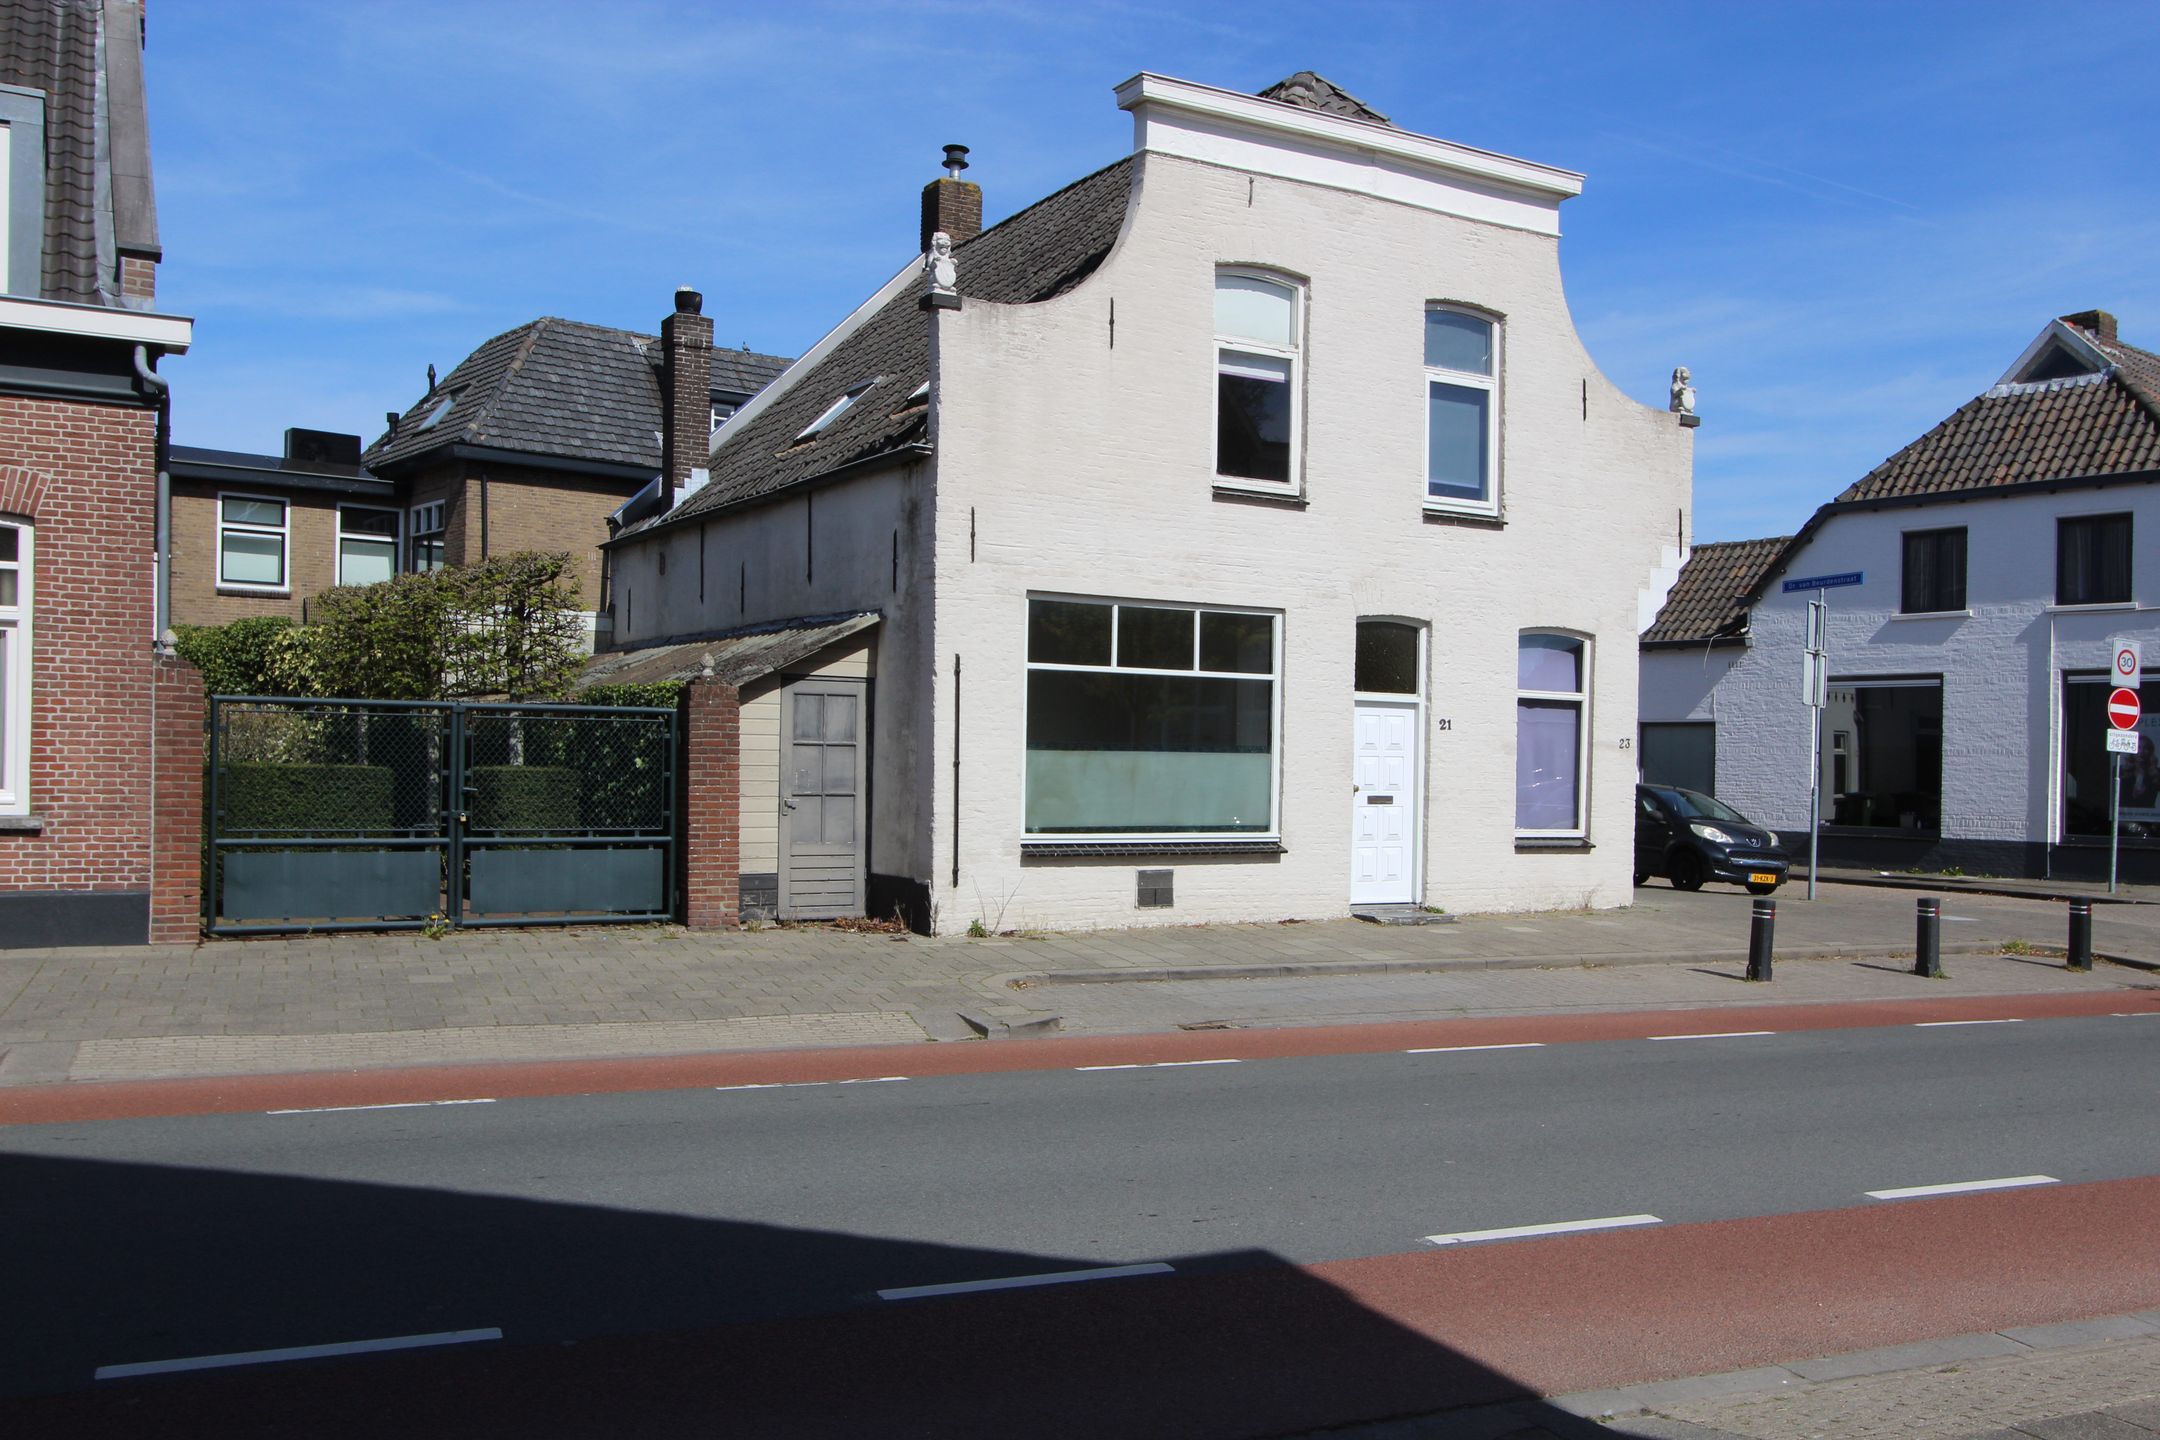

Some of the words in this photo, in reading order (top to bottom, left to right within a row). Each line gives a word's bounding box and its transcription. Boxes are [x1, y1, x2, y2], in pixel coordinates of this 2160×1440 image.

[2120, 656, 2133, 668] 30
[1438, 718, 1452, 731] 21
[1618, 738, 1631, 749] 23
